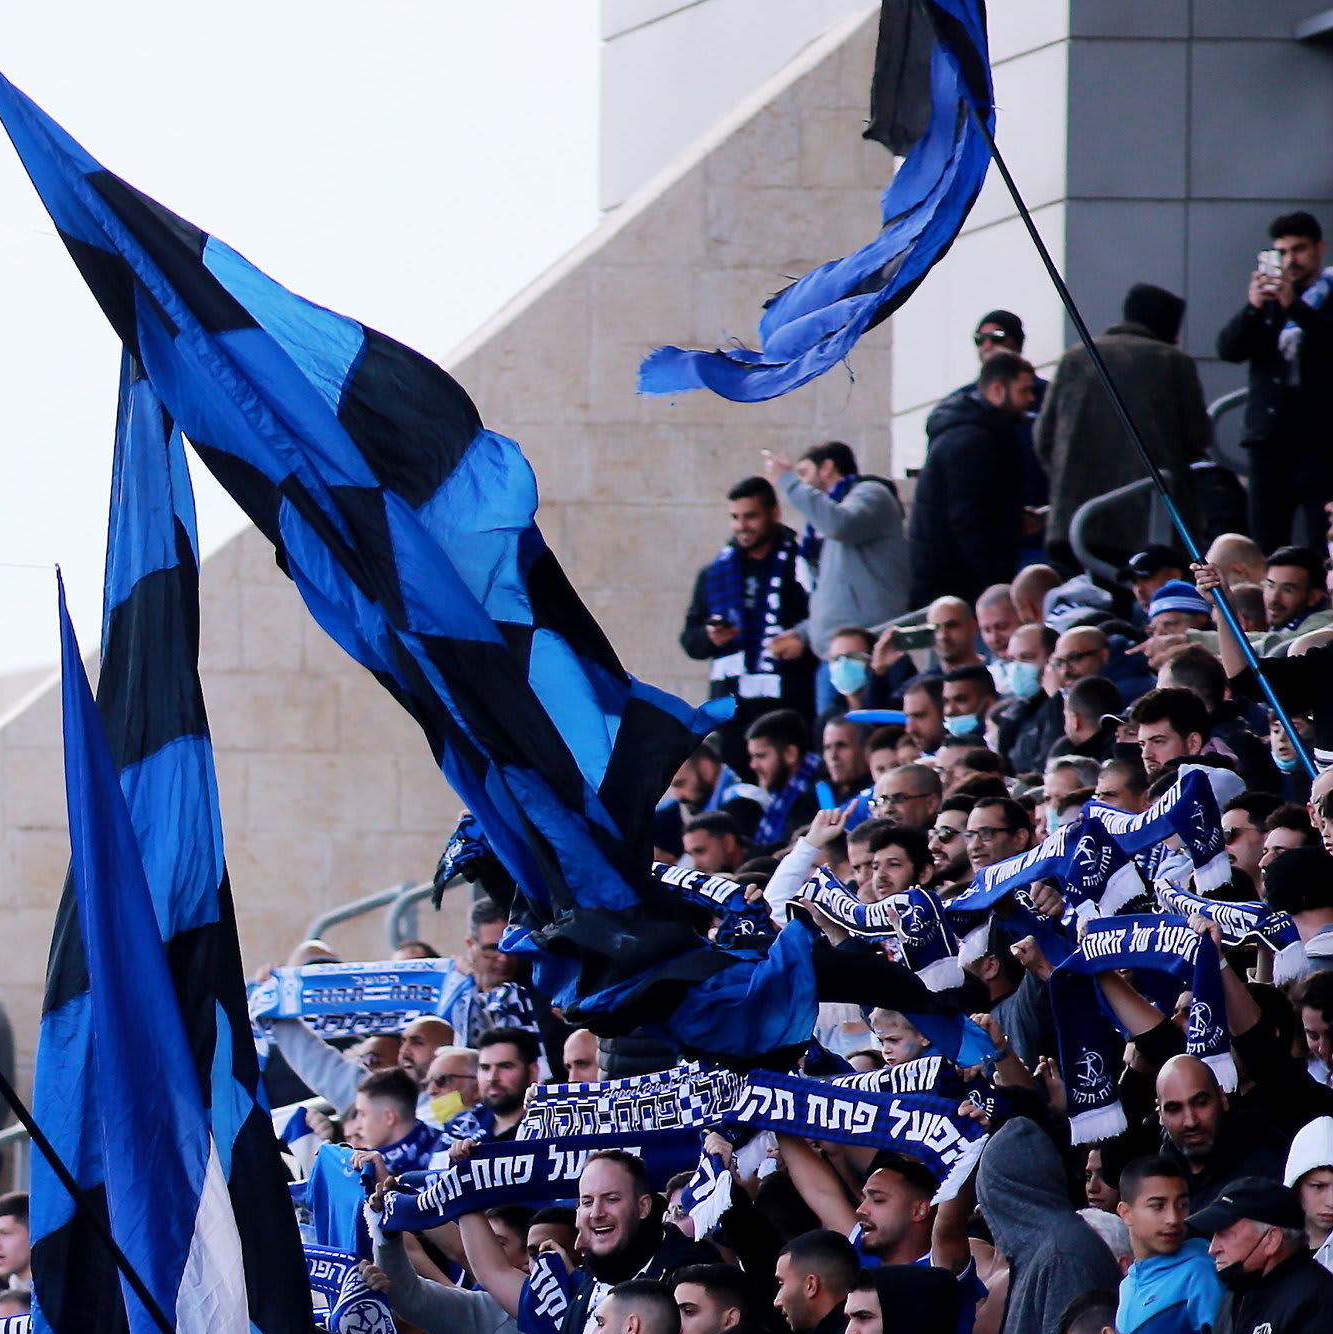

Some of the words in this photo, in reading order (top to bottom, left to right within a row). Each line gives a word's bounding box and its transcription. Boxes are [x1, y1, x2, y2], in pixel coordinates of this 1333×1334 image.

[1128, 920, 1156, 953] של
[733, 1083, 797, 1124] תקו
[805, 1095, 879, 1134] פתח
